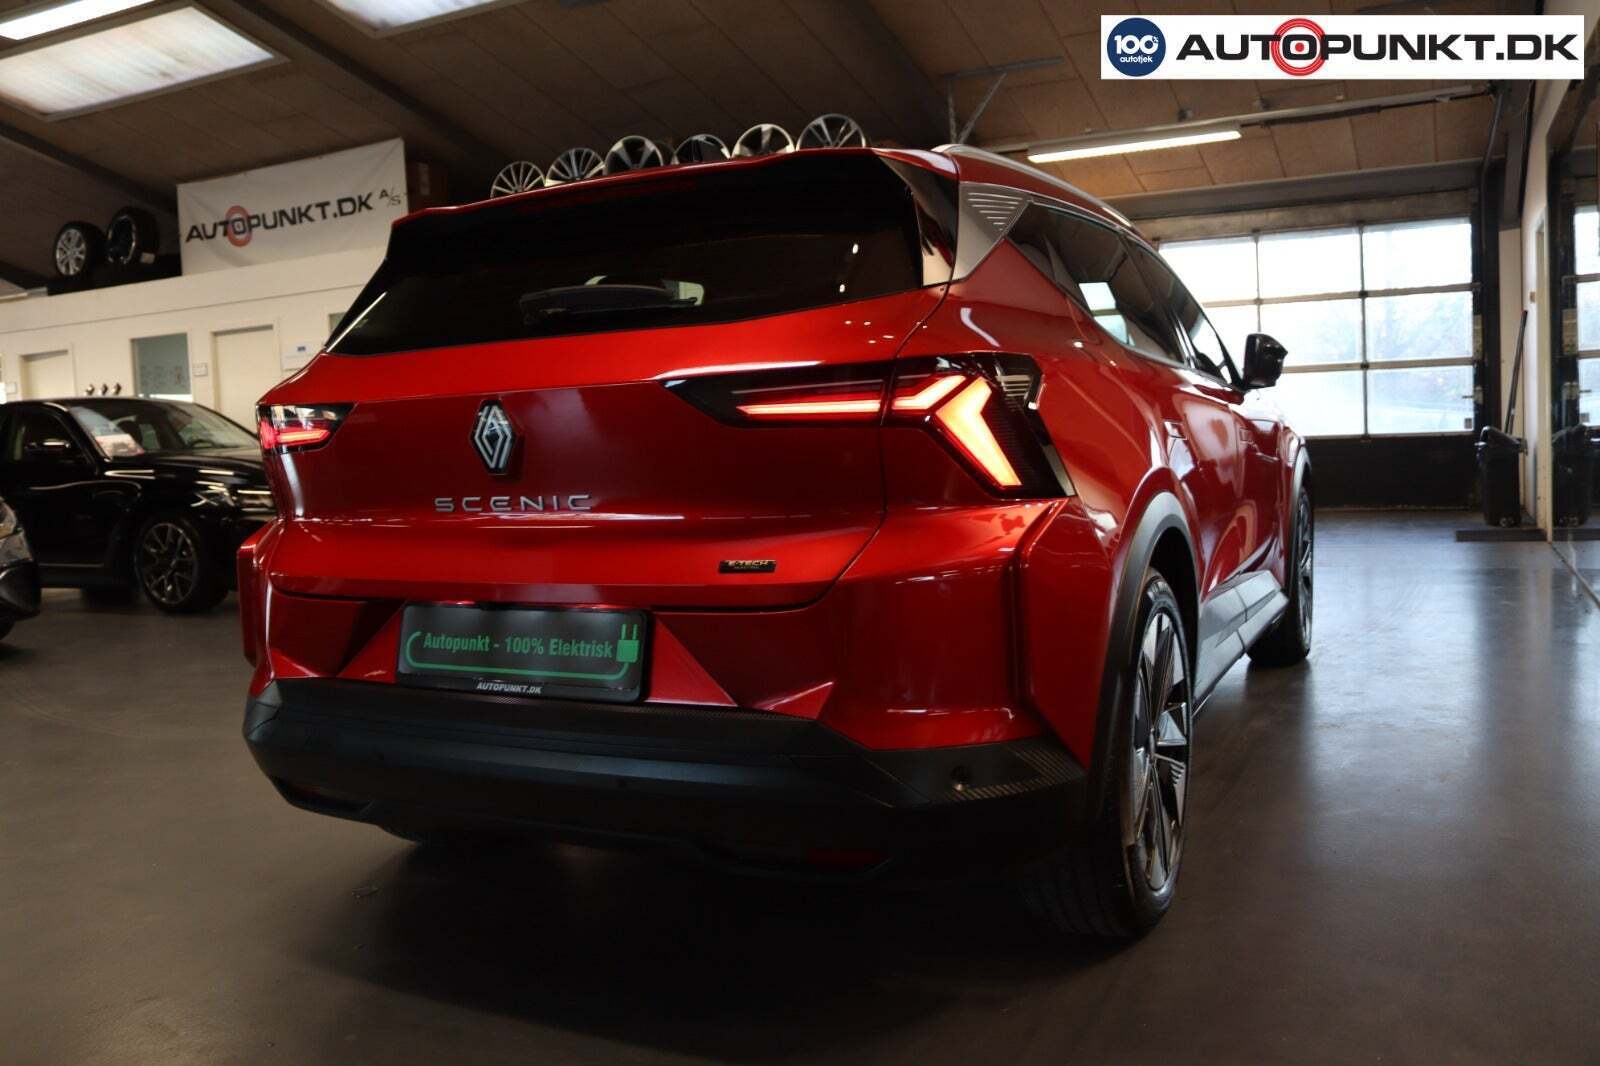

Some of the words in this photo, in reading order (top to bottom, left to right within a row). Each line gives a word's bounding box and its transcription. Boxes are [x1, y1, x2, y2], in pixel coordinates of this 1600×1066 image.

[185, 192, 373, 243] AUTOPUNKT.DK
[378, 186, 401, 208] A/S
[434, 494, 593, 512] SCENIC
[423, 631, 490, 652] Autopunkt
[504, 636, 544, 655] 100%
[549, 640, 613, 659] Elektrisk
[476, 682, 543, 694] AUTOPUNKT.DK
